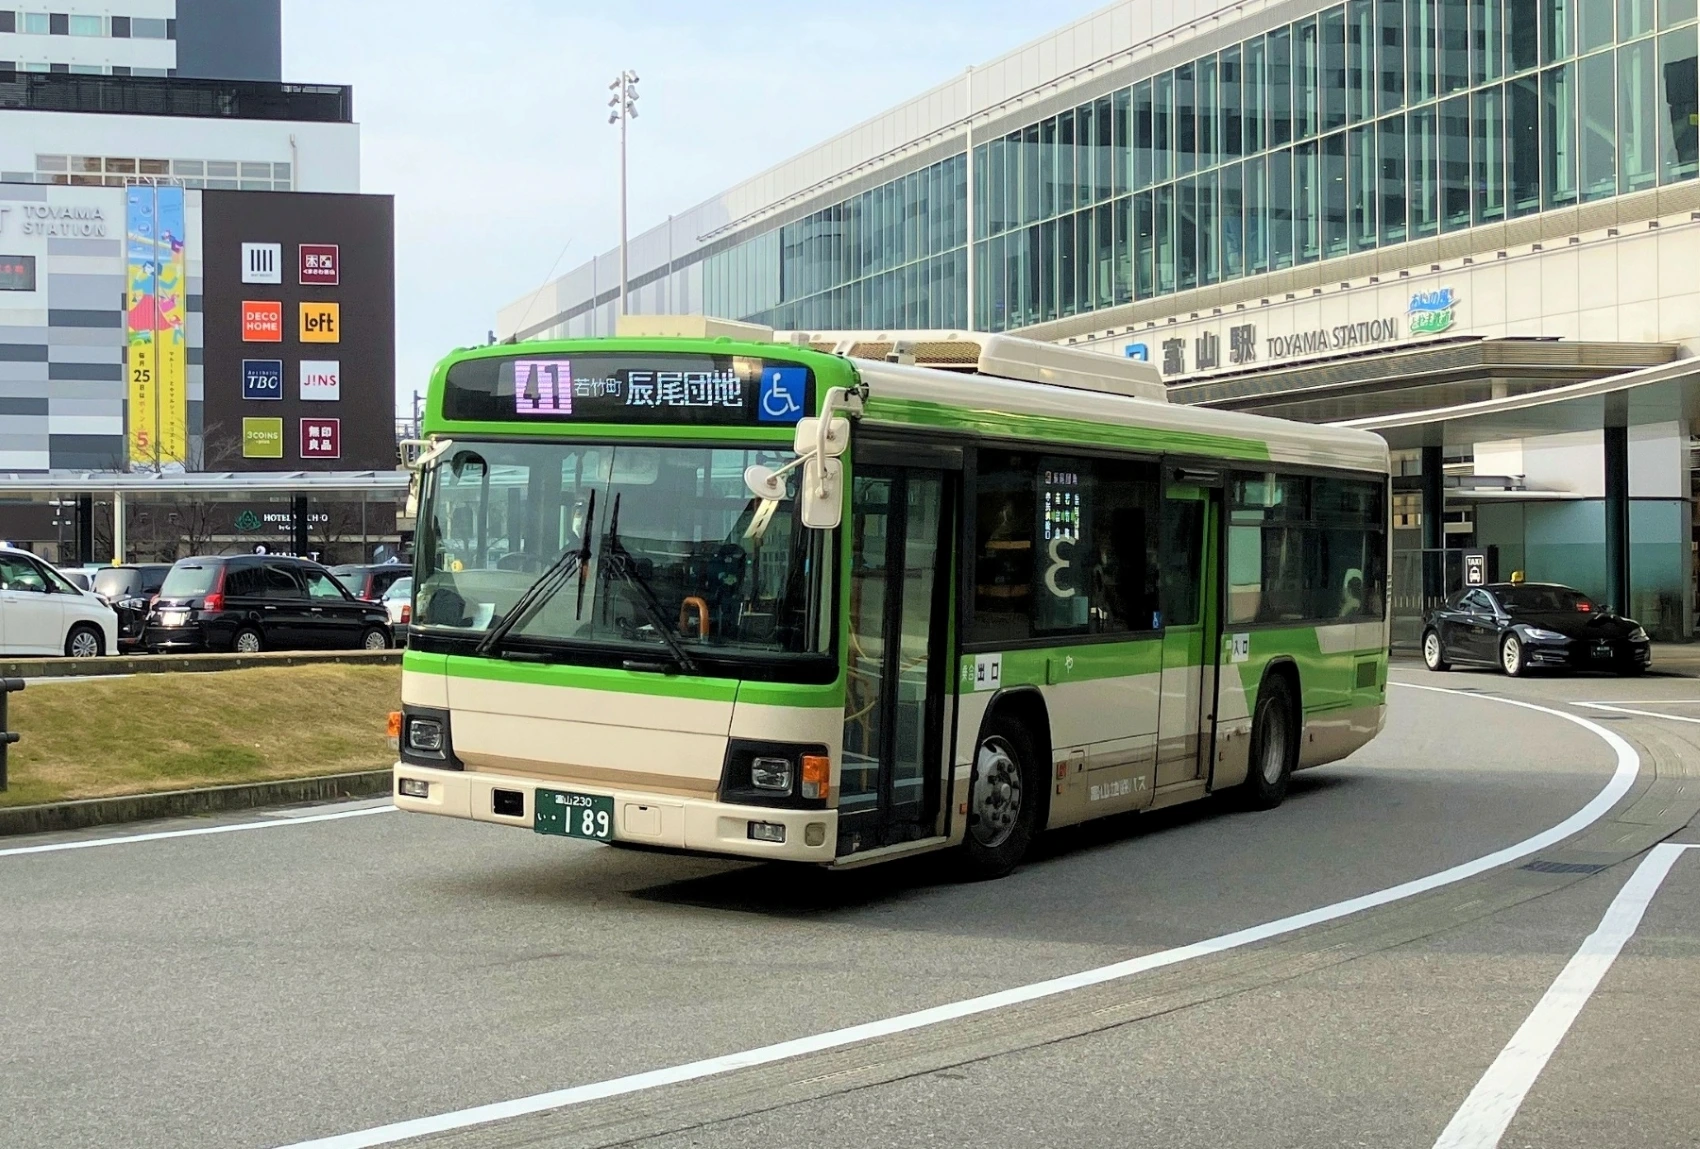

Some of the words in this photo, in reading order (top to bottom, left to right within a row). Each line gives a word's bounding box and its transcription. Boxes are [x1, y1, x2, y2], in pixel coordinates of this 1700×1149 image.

[23, 206, 105, 220] TOYAMA
[23, 222, 106, 237] STATION
[246, 312, 278, 321] DECO
[246, 322, 278, 331] HOME
[1267, 329, 1328, 358] TOYAMA
[1332, 317, 1396, 348] STATION
[1162, 323, 1256, 376] 富山駅
[247, 376, 279, 389] TBC
[521, 362, 563, 411] 41
[574, 378, 622, 398] 若竹町
[626, 369, 743, 408] 辰尾団地
[247, 430, 279, 440] 3COINS
[309, 438, 332, 451] 良品
[263, 514, 292, 522] HOTEL
[1467, 558, 1482, 566] TAXI
[1234, 640, 1248, 656] 入口
[977, 662, 999, 682] 出口
